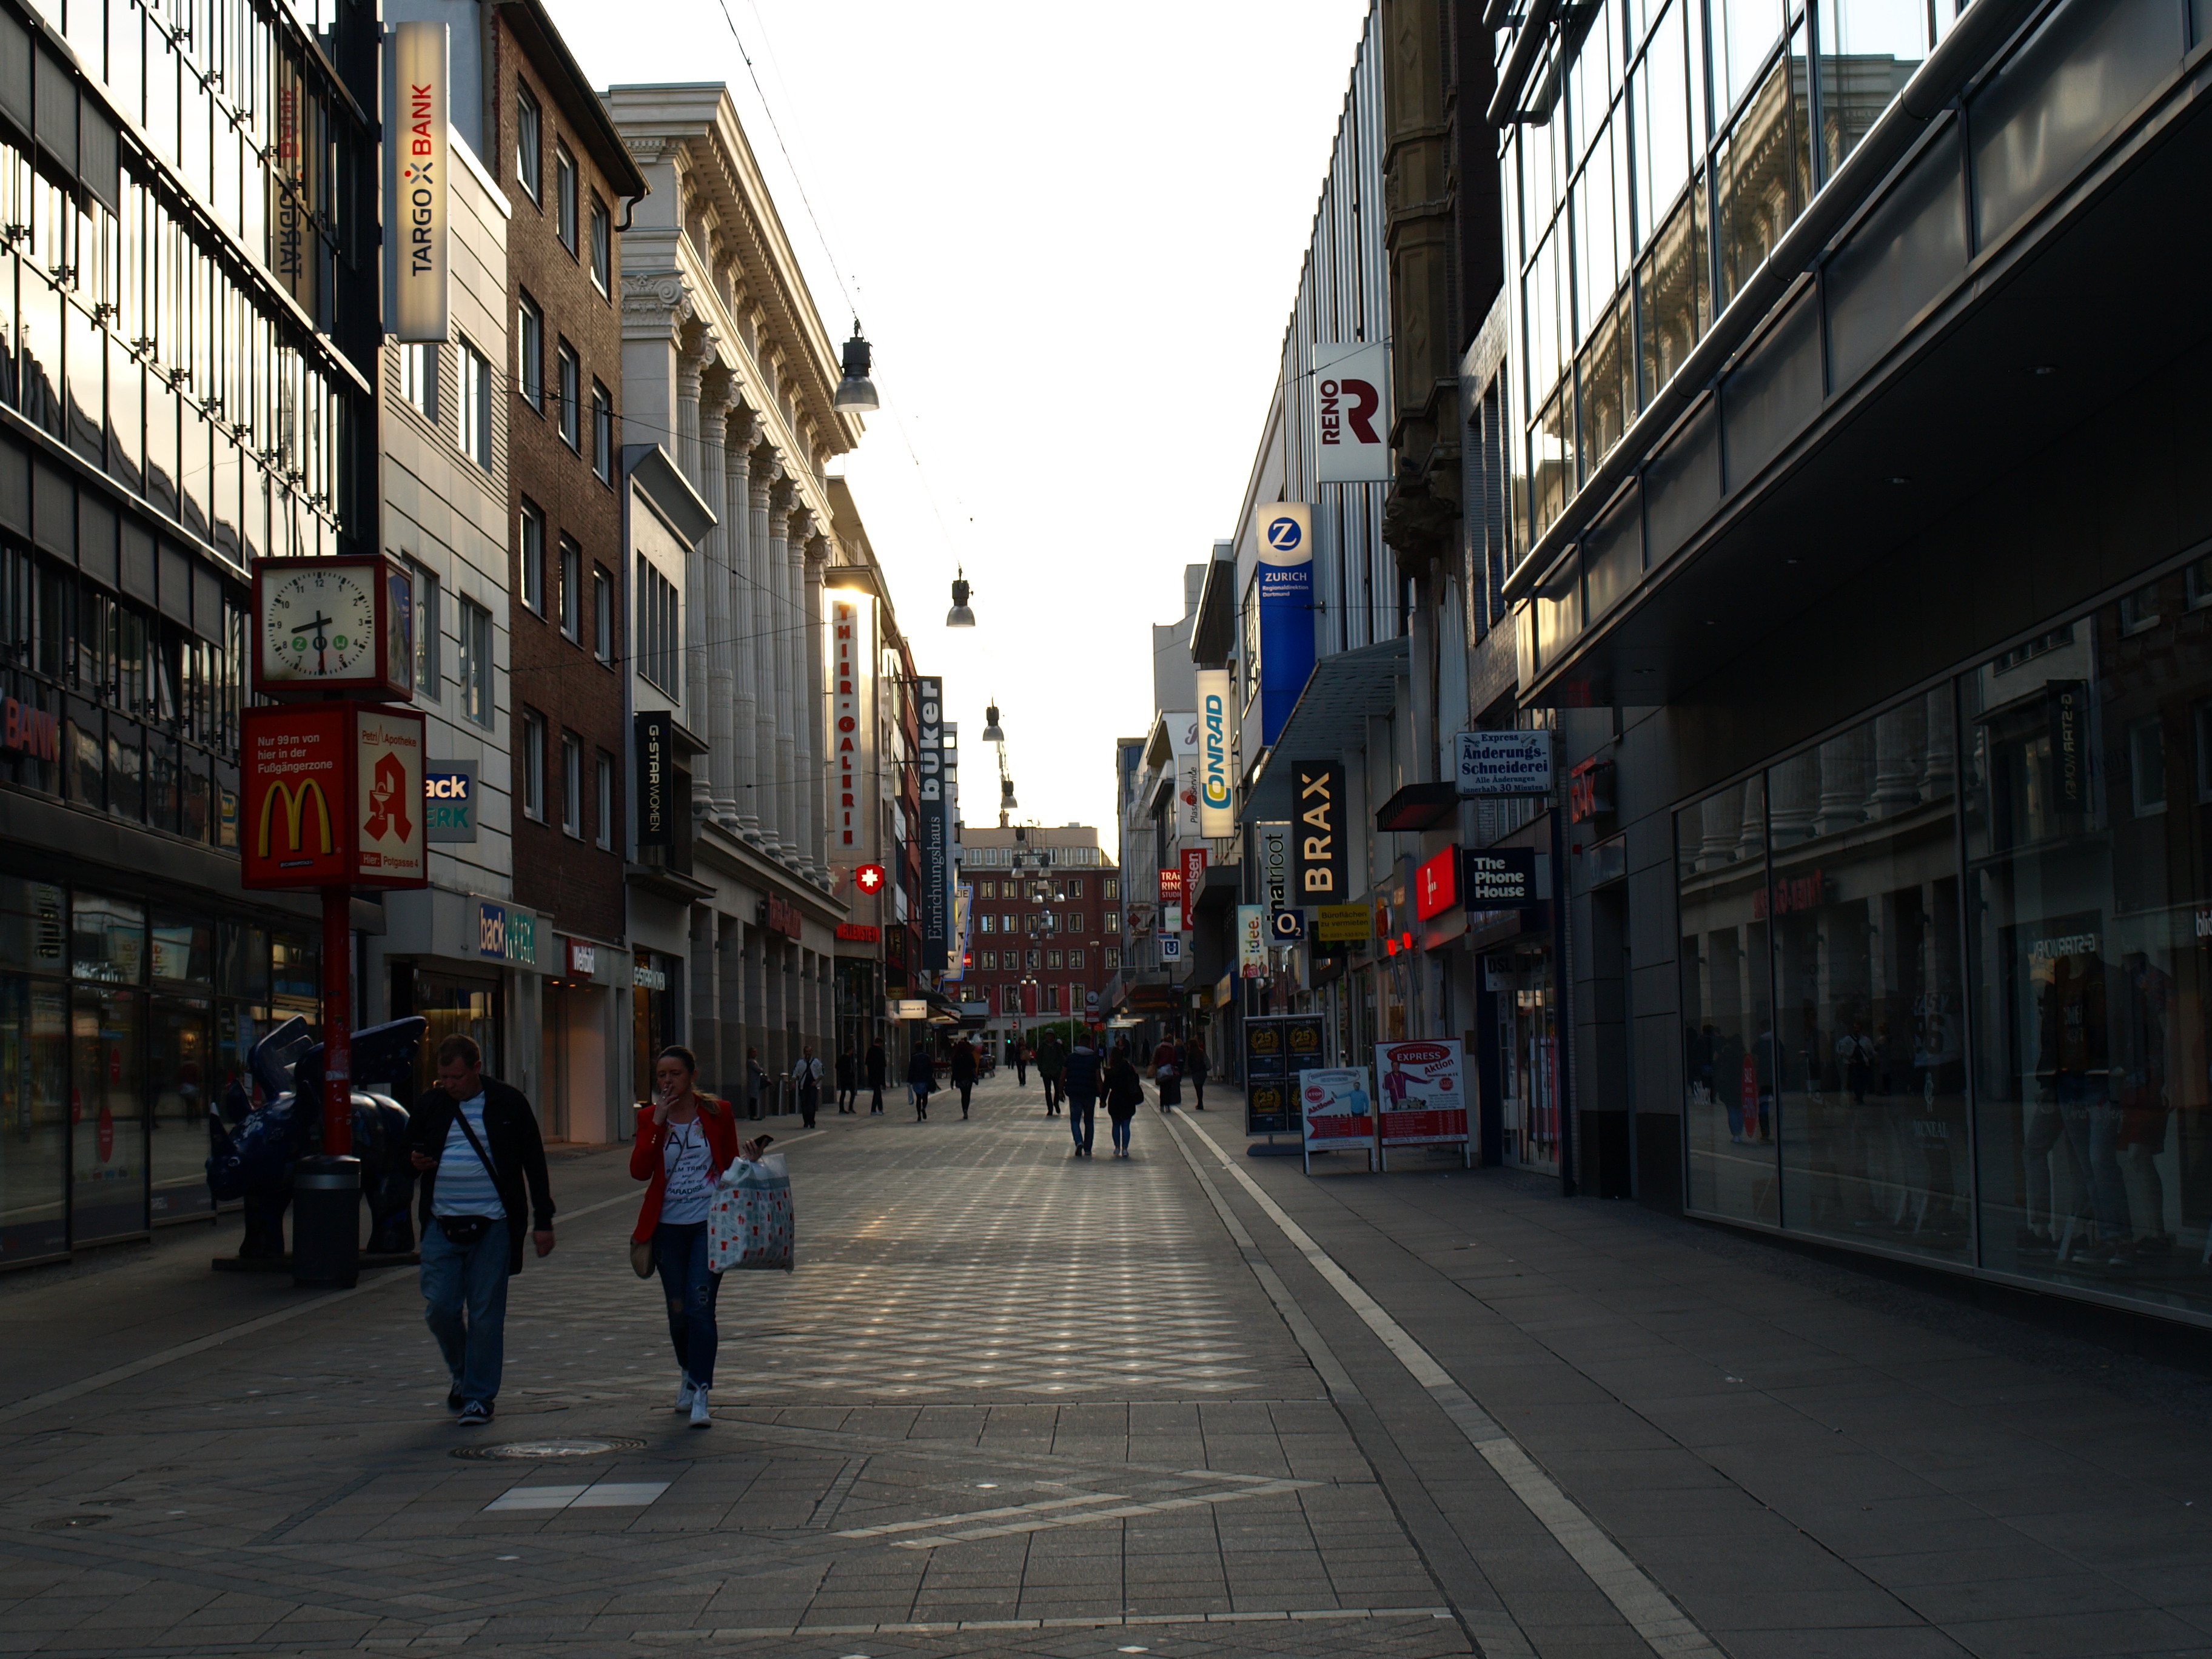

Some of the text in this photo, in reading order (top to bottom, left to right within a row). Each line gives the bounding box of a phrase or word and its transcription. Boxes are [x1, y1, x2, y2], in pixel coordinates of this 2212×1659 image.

[412, 84, 432, 276] TARGO BANK
[1321, 380, 1339, 444] RENO
[1341, 379, 1381, 443] R
[315, 579, 324, 588] 12
[1265, 572, 1307, 582] ZURICH
[296, 585, 304, 594] 11
[283, 640, 288, 649] 8
[4, 695, 59, 763] BANK
[837, 605, 856, 844] THIER-GALERIE
[258, 736, 274, 746] Nur
[302, 734, 320, 743] von
[363, 730, 417, 747] Petri Apotheke
[919, 681, 940, 802] büker
[258, 748, 306, 760] hier in der
[1202, 694, 1231, 811] CONRAD
[1463, 745, 1546, 760] Änderungs-
[258, 760, 333, 776] Fußgängerzone
[1462, 760, 1547, 775] Schneiderei
[426, 776, 467, 799] ack
[426, 807, 469, 828] ERK
[1302, 772, 1333, 892] BRAX
[363, 854, 418, 868] Hier: Potgasse 4
[1473, 857, 1506, 870] The
[927, 816, 945, 940] Einrichtungshaus
[1474, 871, 1525, 885] Phone
[1475, 886, 1525, 899] House
[480, 907, 504, 953] back
[1245, 916, 1260, 953] idee.
[1166, 942, 1177, 954] U
[1257, 1032, 1272, 1045] 25
[1296, 1030, 1311, 1043] 25
[1396, 1051, 1441, 1062] EXPRESS
[1425, 1059, 1454, 1074] Aktion
[1259, 1091, 1274, 1104] 25
[1308, 1098, 1335, 1114] Aktion!
[666, 1184, 705, 1195] PARADISE
